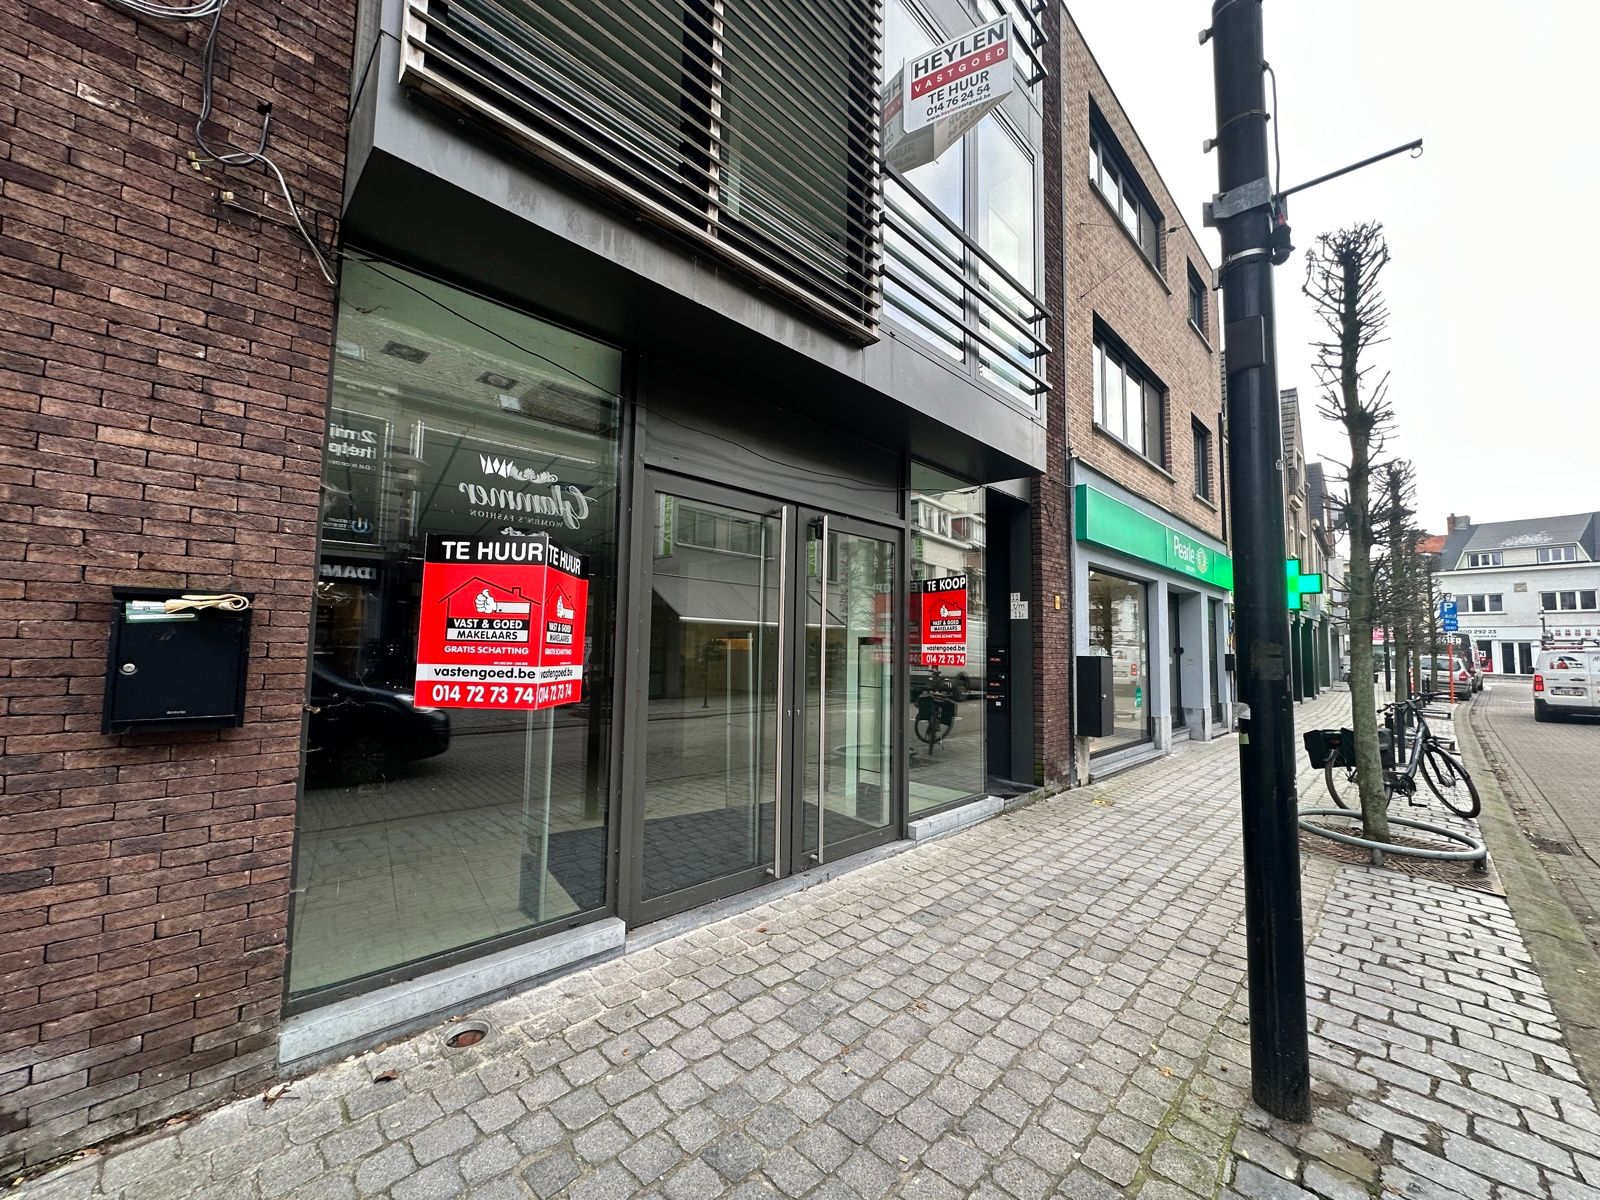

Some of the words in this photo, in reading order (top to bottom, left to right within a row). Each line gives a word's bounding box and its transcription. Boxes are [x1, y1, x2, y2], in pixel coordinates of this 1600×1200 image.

[915, 23, 1004, 78] HEYLEN
[915, 47, 1004, 92] VASTGOED
[928, 89, 944, 104] TE
[949, 70, 989, 96] HUUR
[927, 104, 944, 117] 014
[946, 96, 959, 108] 76
[961, 90, 974, 101] 24
[977, 83, 990, 95] 54
[442, 541, 470, 560] TE
[478, 542, 543, 561] HUUR
[1173, 535, 1195, 564] Pearle
[549, 545, 558, 566] TE
[560, 550, 581, 575] HUUR
[927, 580, 936, 592] TE
[940, 577, 966, 591] KOOP
[1444, 603, 1453, 612] P
[454, 619, 479, 628] VAST
[482, 619, 489, 628] &
[493, 619, 522, 629] GOED
[549, 622, 557, 632] VAST
[562, 623, 571, 633] GOED
[457, 630, 517, 640] MAKELAARS
[444, 646, 476, 654] GRATIS
[477, 646, 529, 655] SCHATTING
[926, 654, 937, 663] 014
[938, 654, 945, 663] 72
[947, 655, 955, 664] 73
[956, 655, 965, 664] 74
[434, 667, 536, 680] vastengoed.be
[540, 668, 573, 680] vastengoed.be
[432, 684, 461, 701] 014
[466, 685, 485, 703] 72
[490, 686, 508, 703] 73
[514, 687, 534, 704] 74
[539, 687, 549, 703] 014
[550, 685, 557, 701] 72
[558, 684, 565, 700] 73
[565, 684, 572, 698] 74
